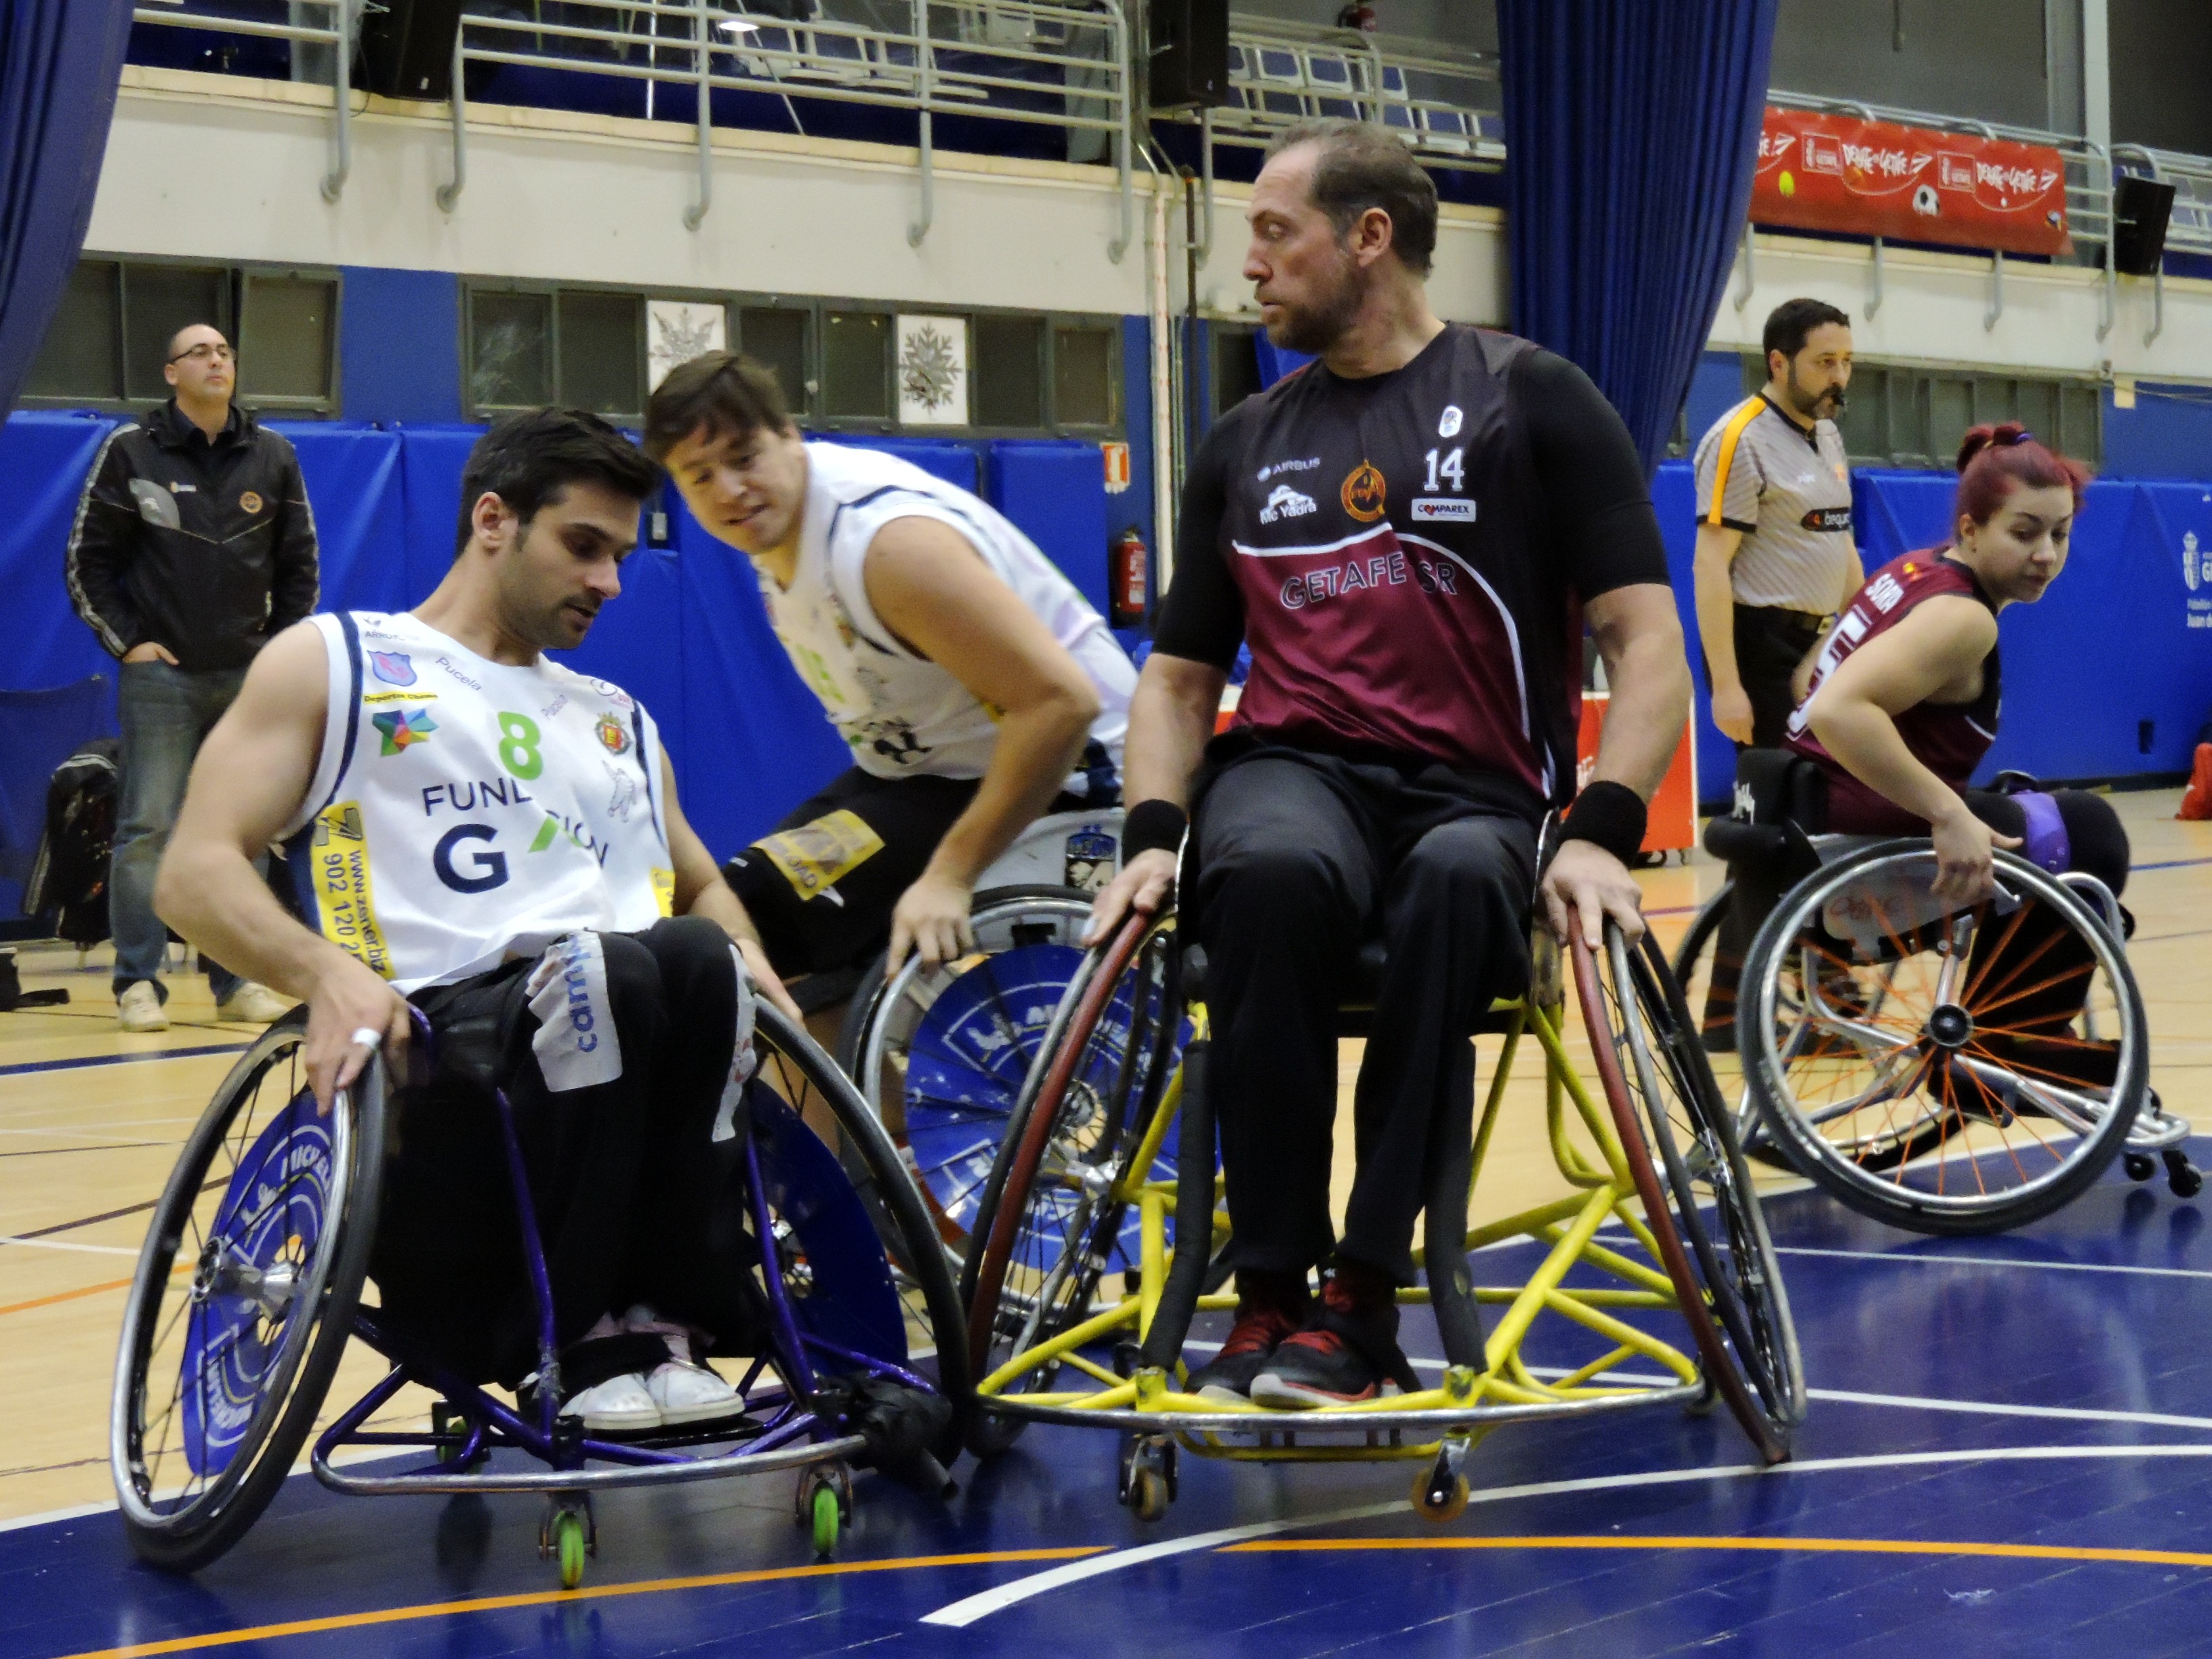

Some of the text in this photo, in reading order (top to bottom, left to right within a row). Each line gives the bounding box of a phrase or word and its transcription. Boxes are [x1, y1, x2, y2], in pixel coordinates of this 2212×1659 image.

[1273, 457, 1321, 475] AIRBUS
[1424, 449, 1465, 491] 14
[1279, 551, 1458, 610] GETAFE SR
[436, 656, 482, 691] Pucela
[497, 711, 544, 781] 8
[323, 853, 348, 895] 902
[333, 900, 357, 937] 120
